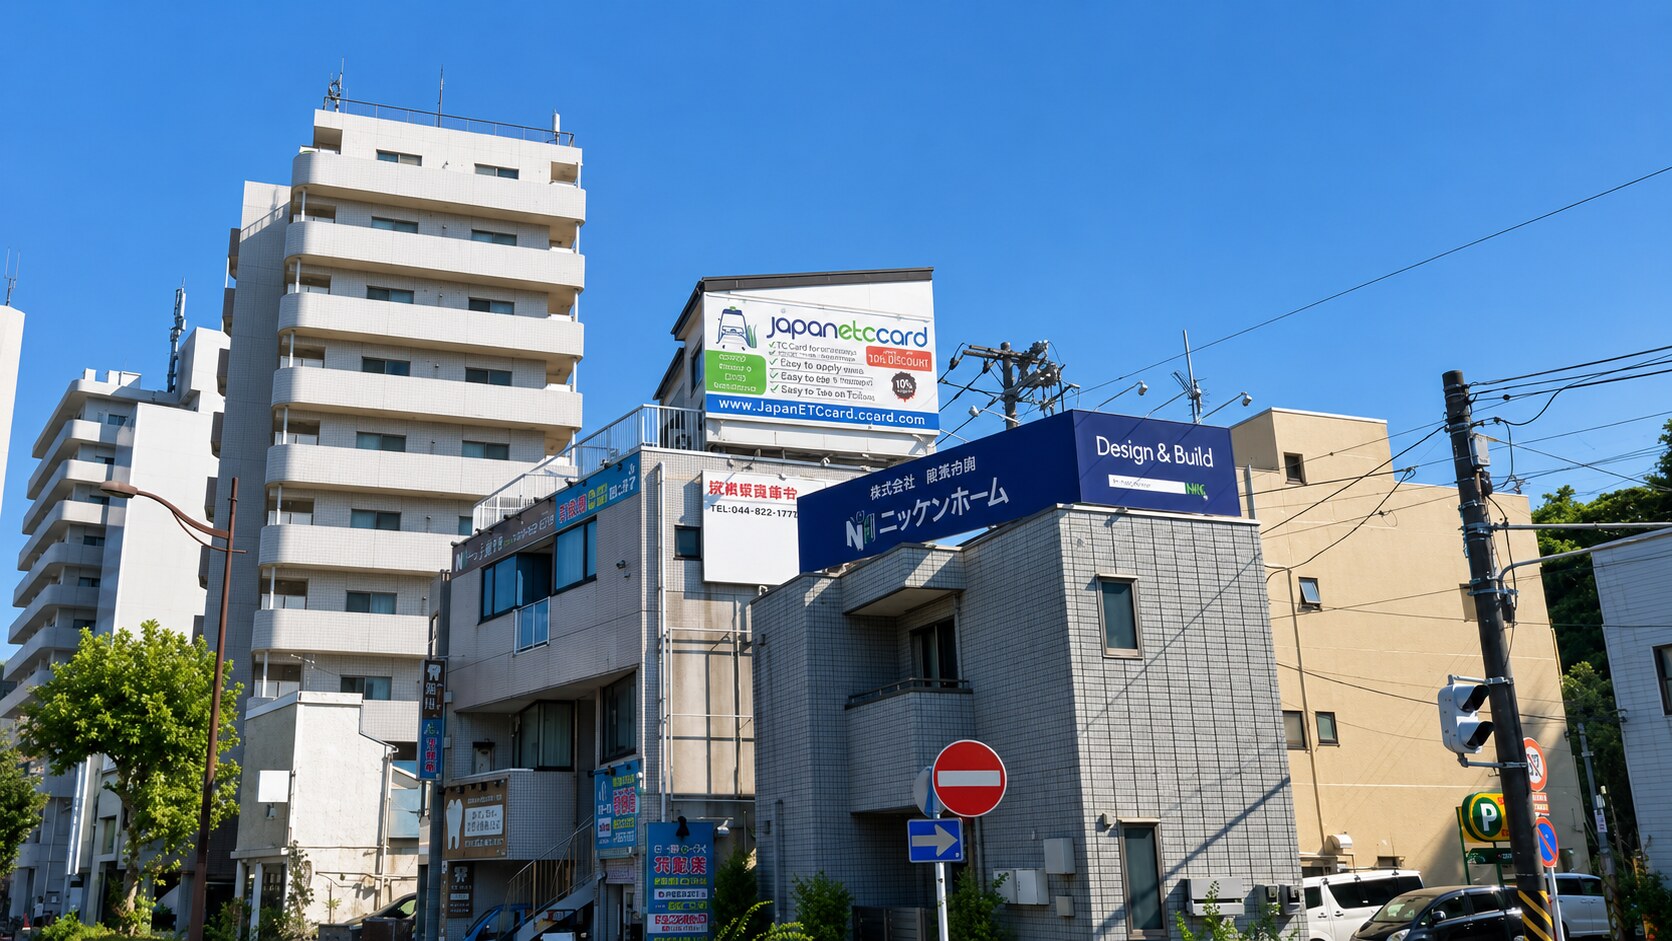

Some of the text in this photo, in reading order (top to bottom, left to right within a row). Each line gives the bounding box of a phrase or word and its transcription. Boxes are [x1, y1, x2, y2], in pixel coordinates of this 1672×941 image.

[804, 361, 814, 370] to
[804, 374, 815, 383] to
[719, 399, 925, 425] www.JapanETCcard.ccard.com
[1096, 435, 1214, 468] Design & Build
[870, 474, 916, 501] 株式会社
[879, 476, 1009, 535] ニッケンホーム
[1480, 802, 1498, 832] P
